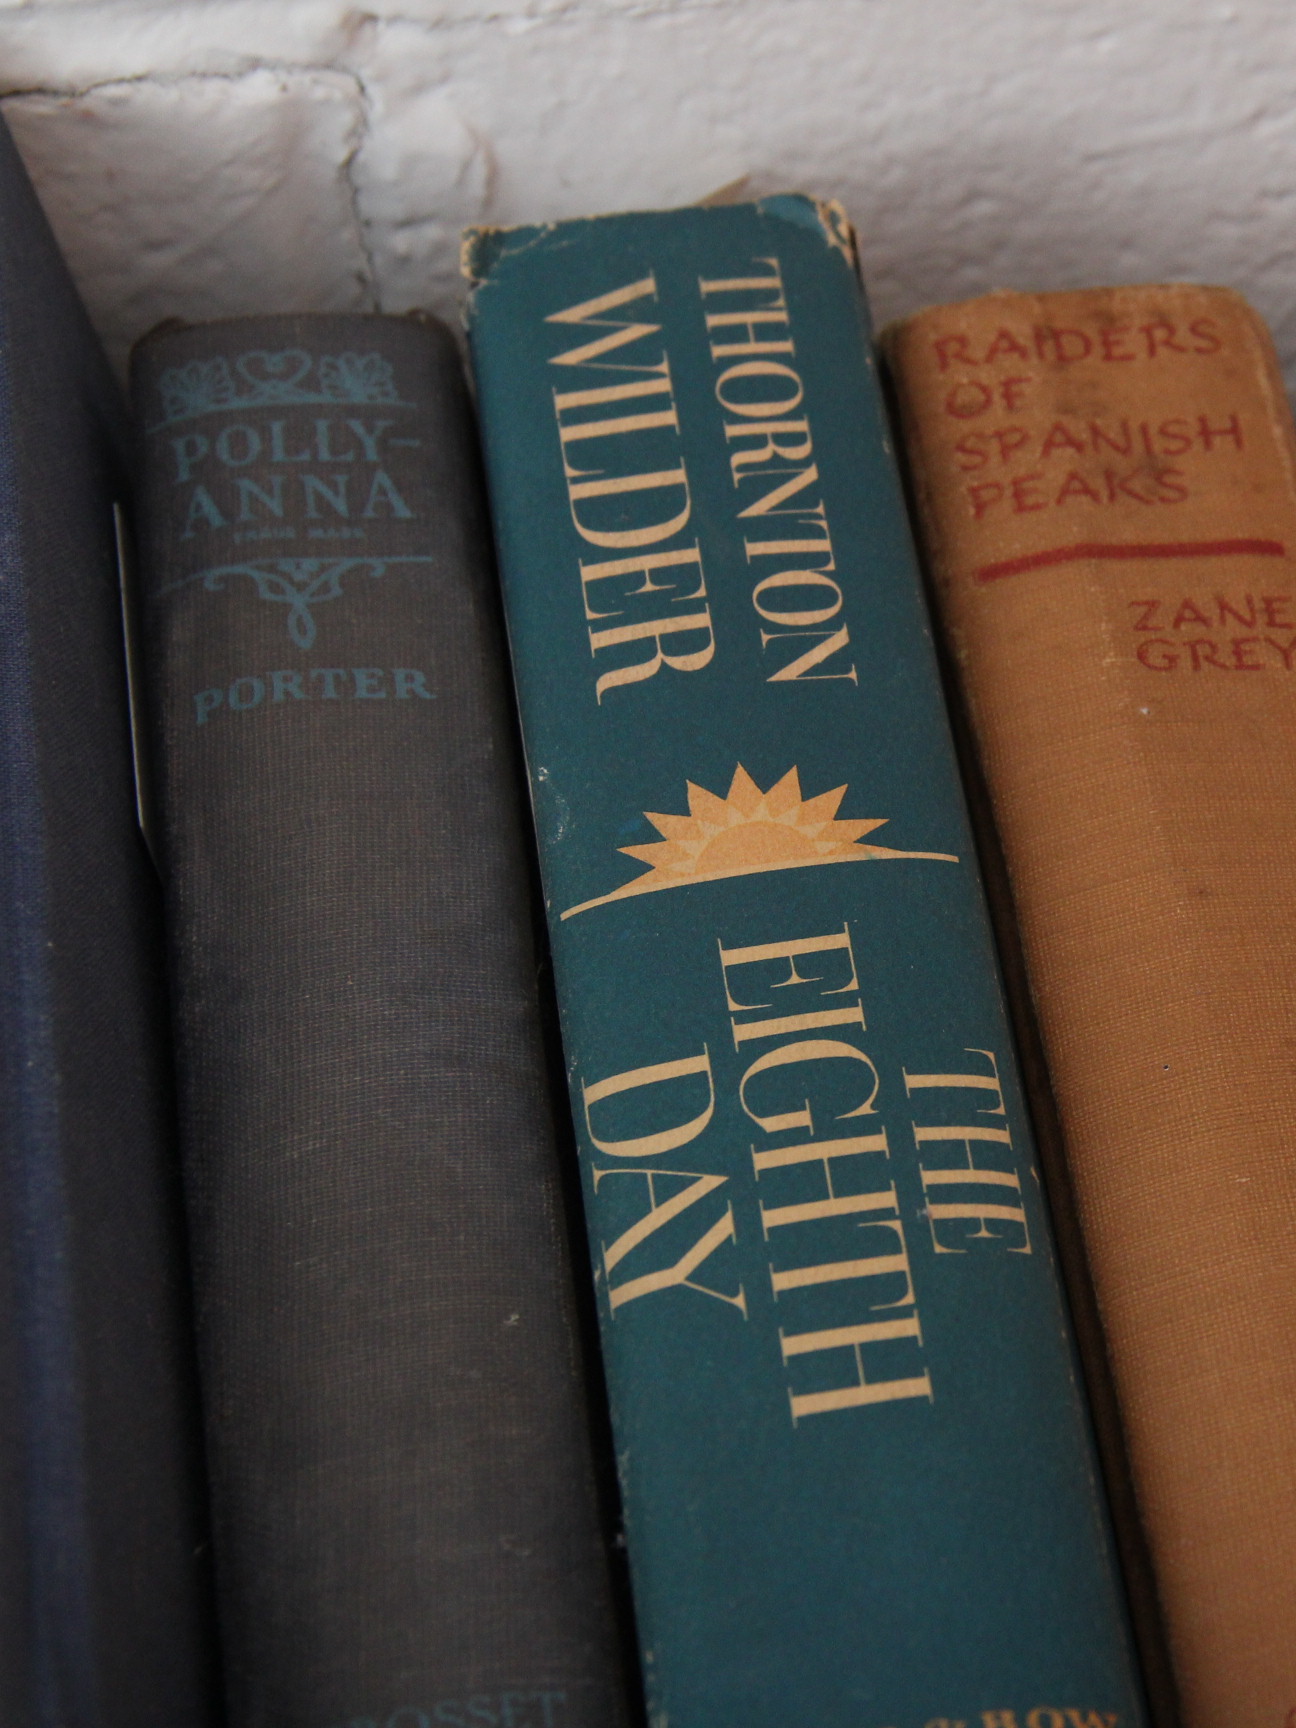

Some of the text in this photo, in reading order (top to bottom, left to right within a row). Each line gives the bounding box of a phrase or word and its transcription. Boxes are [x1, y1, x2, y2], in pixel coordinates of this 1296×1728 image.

[933, 317, 1222, 373] RAIDERS
[945, 376, 1032, 419] OF
[172, 418, 420, 483] POLLY-
[698, 256, 858, 687] THORNTON
[955, 412, 1244, 472] SPANISH
[181, 469, 417, 541] ANNA
[542, 269, 716, 706] WILDER
[967, 467, 1190, 520] PEAKS
[193, 666, 437, 725] PORTER
[581, 1042, 748, 1320] DAY
[717, 920, 935, 1428] EIGHTH
[902, 1047, 1032, 1254] THE
